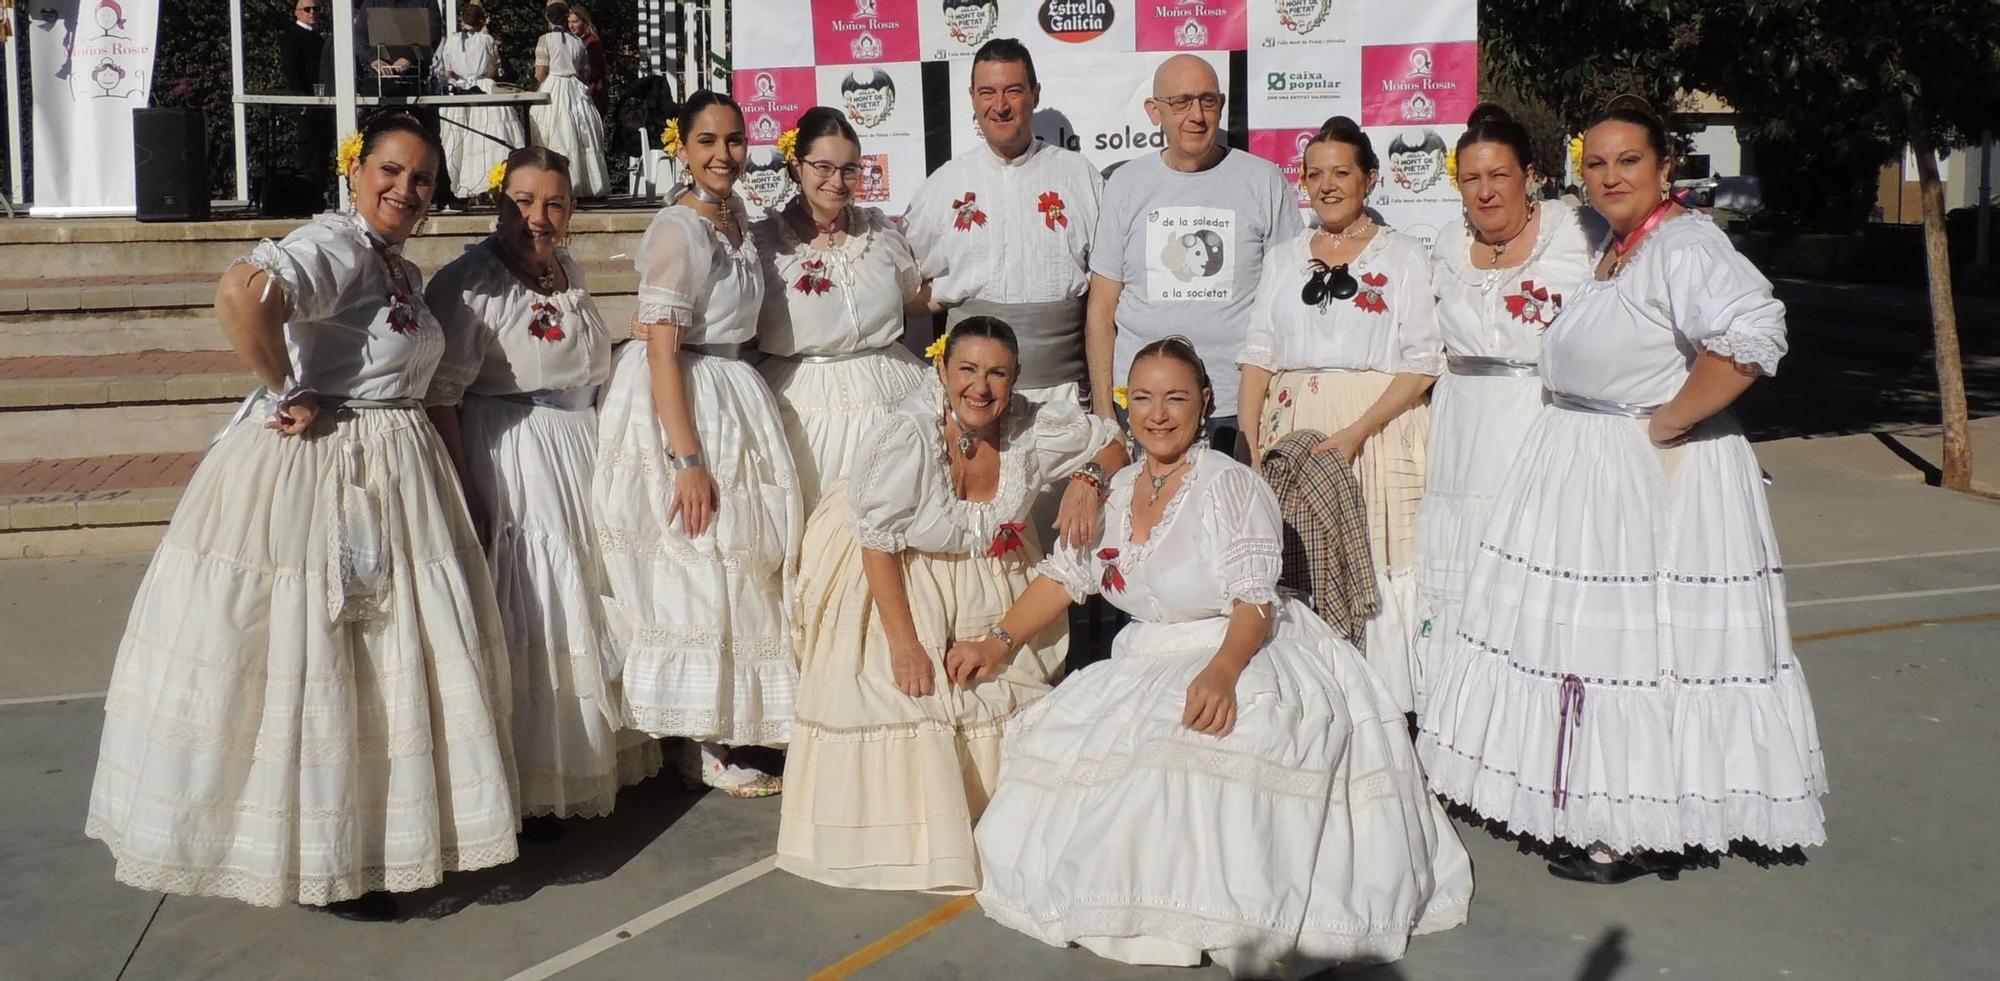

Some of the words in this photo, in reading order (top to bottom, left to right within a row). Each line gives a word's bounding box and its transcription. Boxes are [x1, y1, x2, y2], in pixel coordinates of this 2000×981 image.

[1048, 0, 1106, 16] Estrella
[1155, 6, 1192, 18] Moños
[1195, 5, 1227, 17] Rosas
[832, 20, 866, 32] Moños
[869, 19, 899, 30] Rosas
[958, 18, 983, 26] PIETAT
[1050, 15, 1103, 31] Galicia
[1289, 71, 1323, 80] caixa
[1289, 80, 1341, 90] popular
[1382, 80, 1420, 92] Moños
[1423, 78, 1456, 90] Rosas
[739, 102, 766, 113] oños
[767, 101, 799, 112] Rosas
[1095, 125, 1165, 150] soled
[1279, 163, 1300, 174] oño
[755, 182, 779, 190] PIETAT
[1162, 218, 1174, 227] de
[1179, 216, 1188, 227] la
[1193, 216, 1229, 228] soledat
[1173, 288, 1182, 298] la
[1187, 288, 1227, 298] societat
